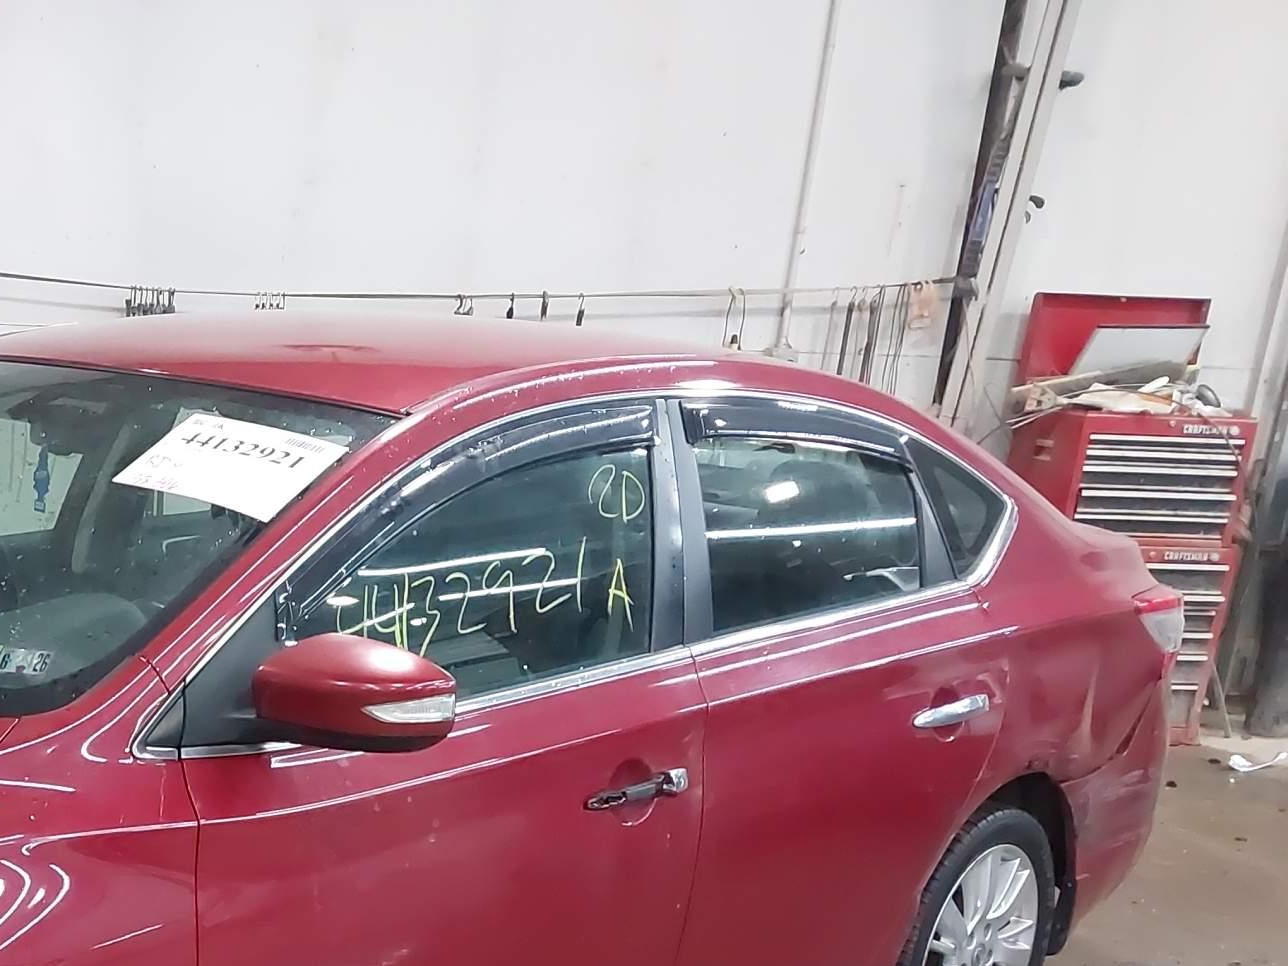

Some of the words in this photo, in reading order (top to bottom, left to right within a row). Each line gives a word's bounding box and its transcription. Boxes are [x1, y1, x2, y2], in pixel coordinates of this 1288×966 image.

[181, 432, 305, 469] 44132921
[0, 653, 11, 670] 6
[32, 652, 51, 672] 26
